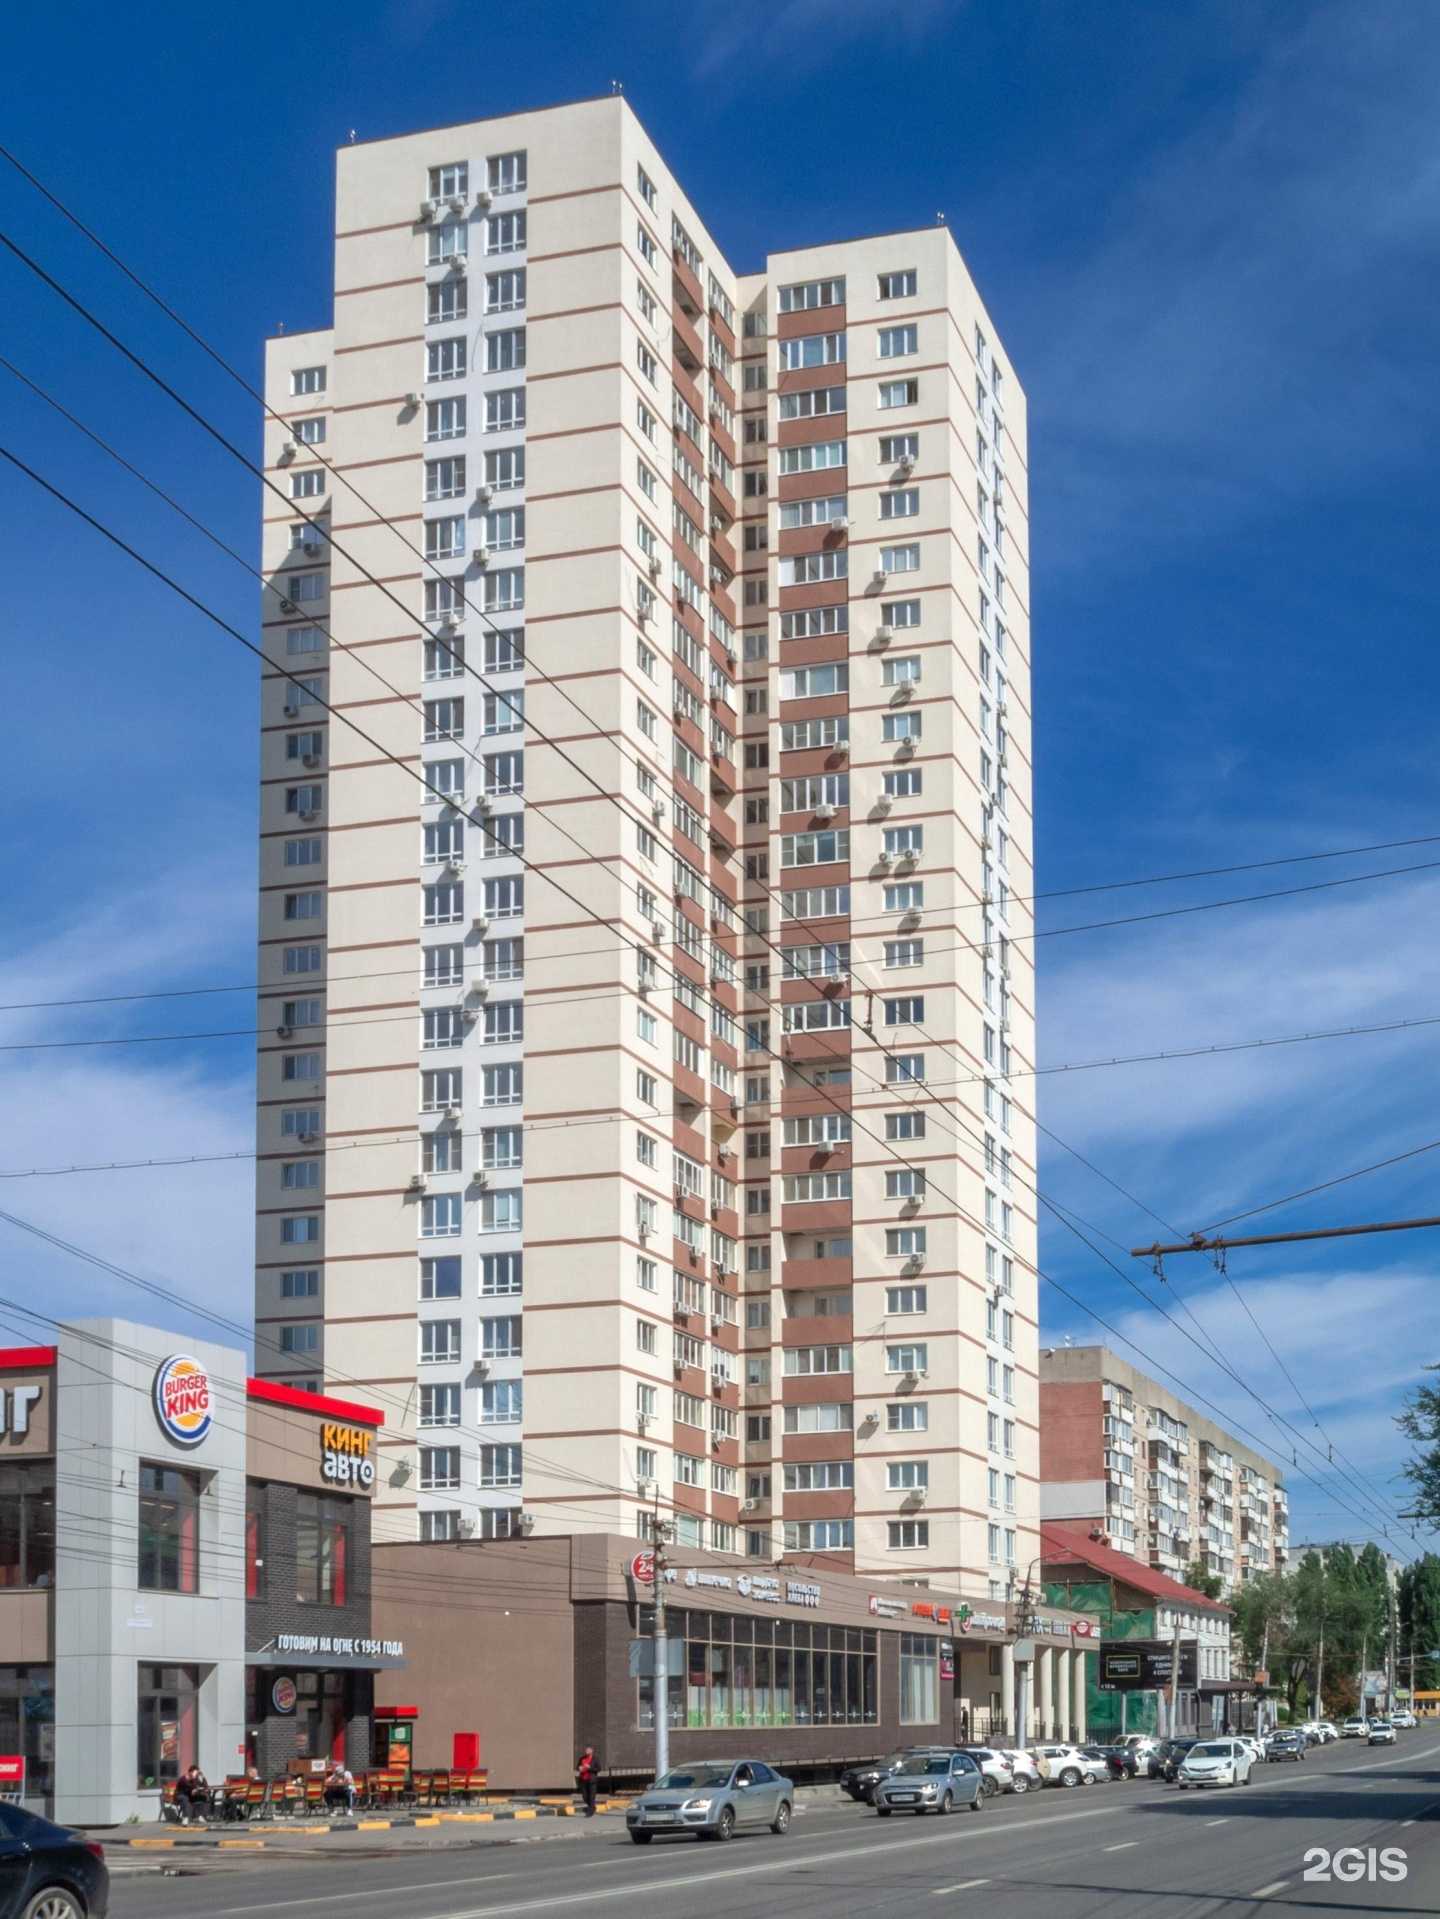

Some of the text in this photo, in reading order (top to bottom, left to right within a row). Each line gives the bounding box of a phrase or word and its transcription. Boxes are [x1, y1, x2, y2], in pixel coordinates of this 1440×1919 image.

[165, 1375, 208, 1398] BURGER
[0, 1386, 40, 1433] Г
[167, 1389, 209, 1418] KING
[278, 1634, 403, 1655] ГОТОВИМ НА ОГНЕ С 1954 ГОДА
